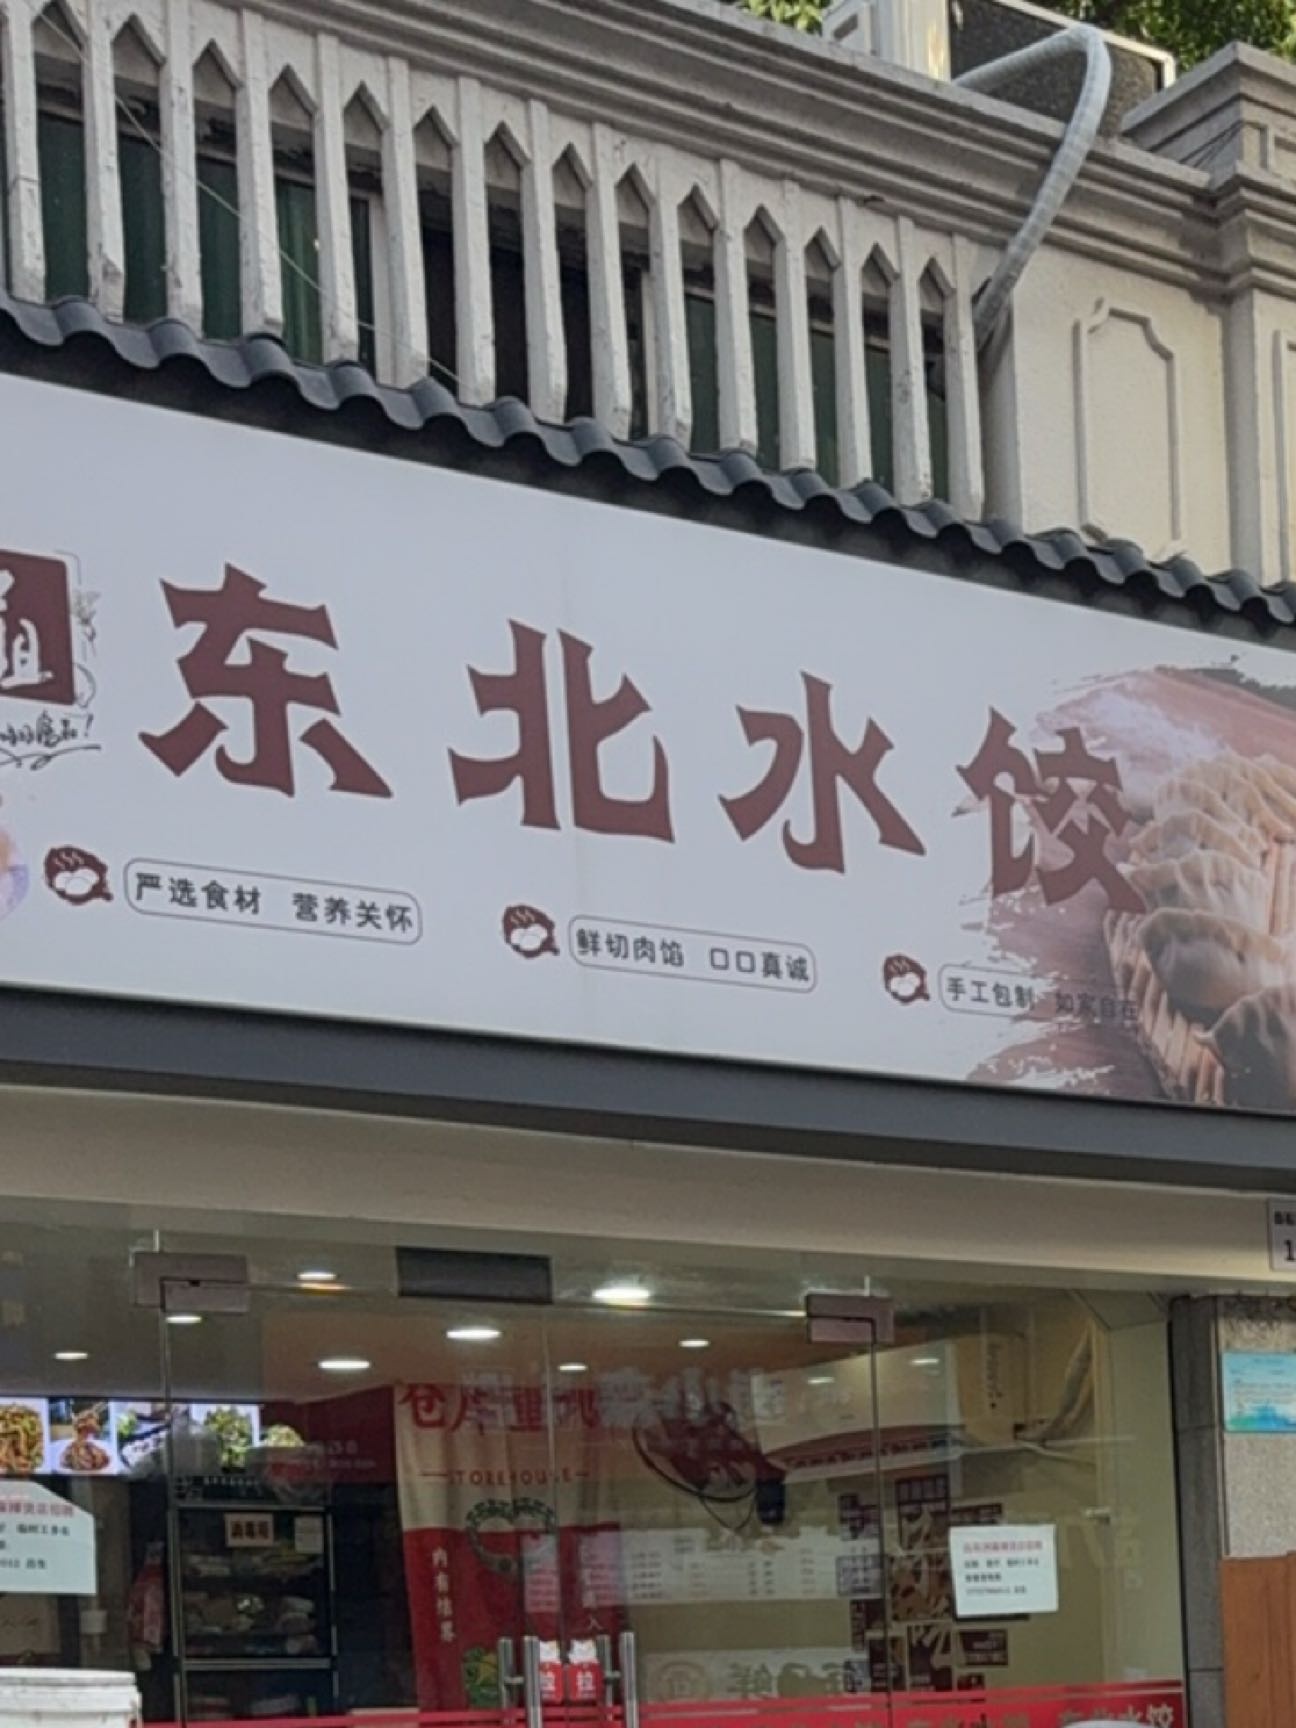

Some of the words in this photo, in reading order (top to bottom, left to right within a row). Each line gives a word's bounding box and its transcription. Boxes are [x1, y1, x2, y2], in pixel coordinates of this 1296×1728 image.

[138, 562, 1147, 914] 东北水饺
[134, 871, 262, 915] 严选食材
[291, 890, 415, 935] 营养关怀
[576, 927, 685, 969] 鲜切肉馅
[709, 945, 811, 985] 口口真诚
[946, 976, 1036, 1009] 手工包制
